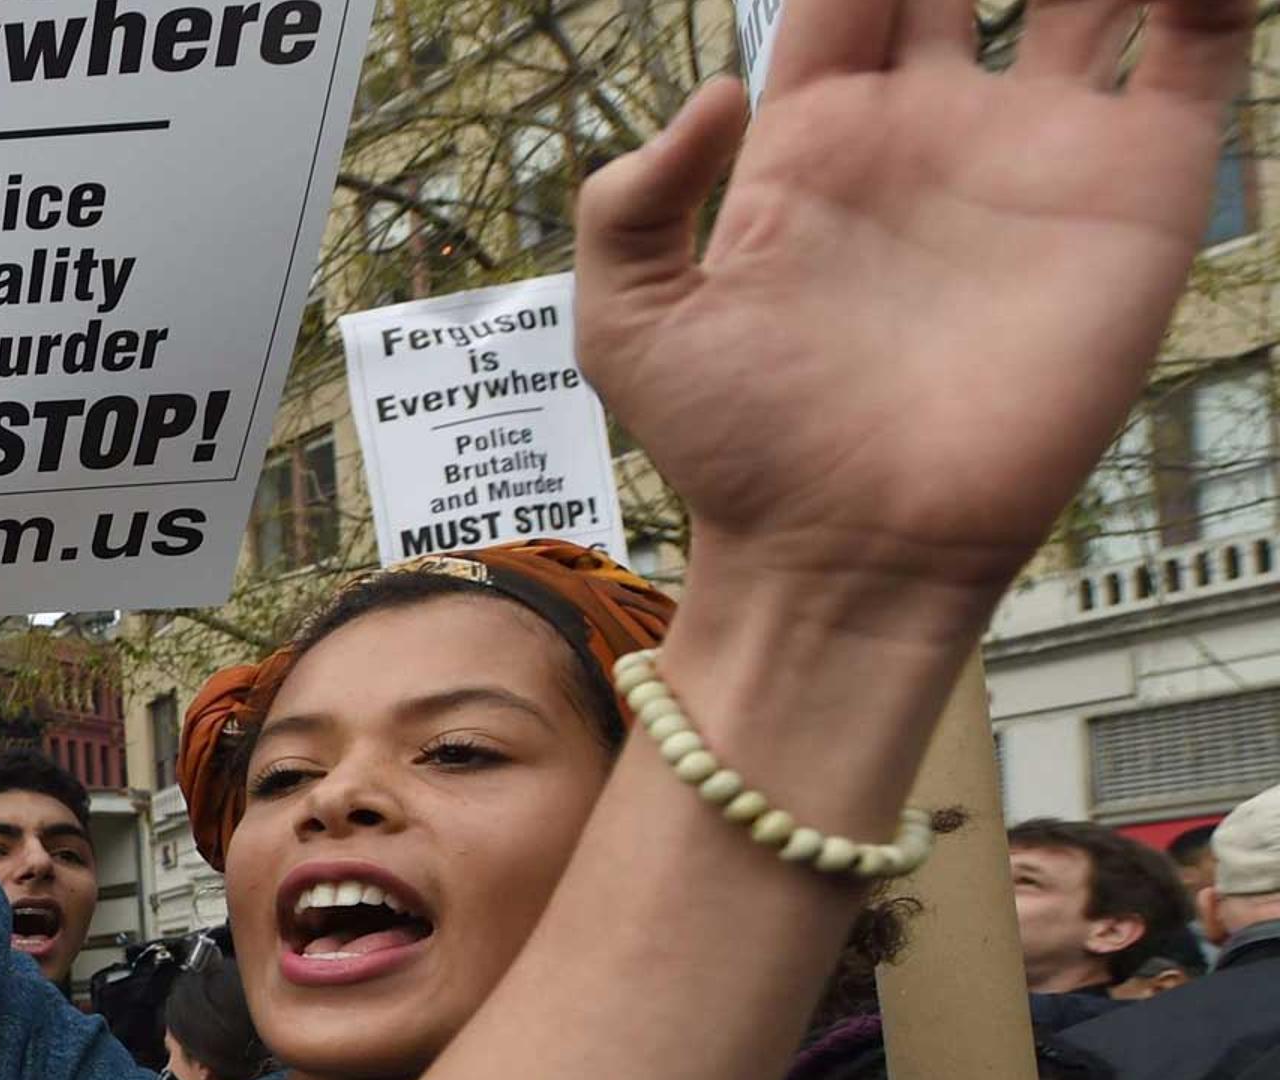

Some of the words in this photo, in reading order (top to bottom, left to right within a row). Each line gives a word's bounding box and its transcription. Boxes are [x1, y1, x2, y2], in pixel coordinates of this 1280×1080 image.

[381, 304, 559, 357] Ferguson
[470, 349, 499, 374] is
[376, 366, 580, 423] Everywhere
[455, 426, 533, 455] Police
[444, 450, 548, 485] Brutality
[430, 488, 479, 514] and
[488, 475, 565, 503] Murder
[400, 511, 501, 558] MUST
[514, 497, 600, 535] STOP!
